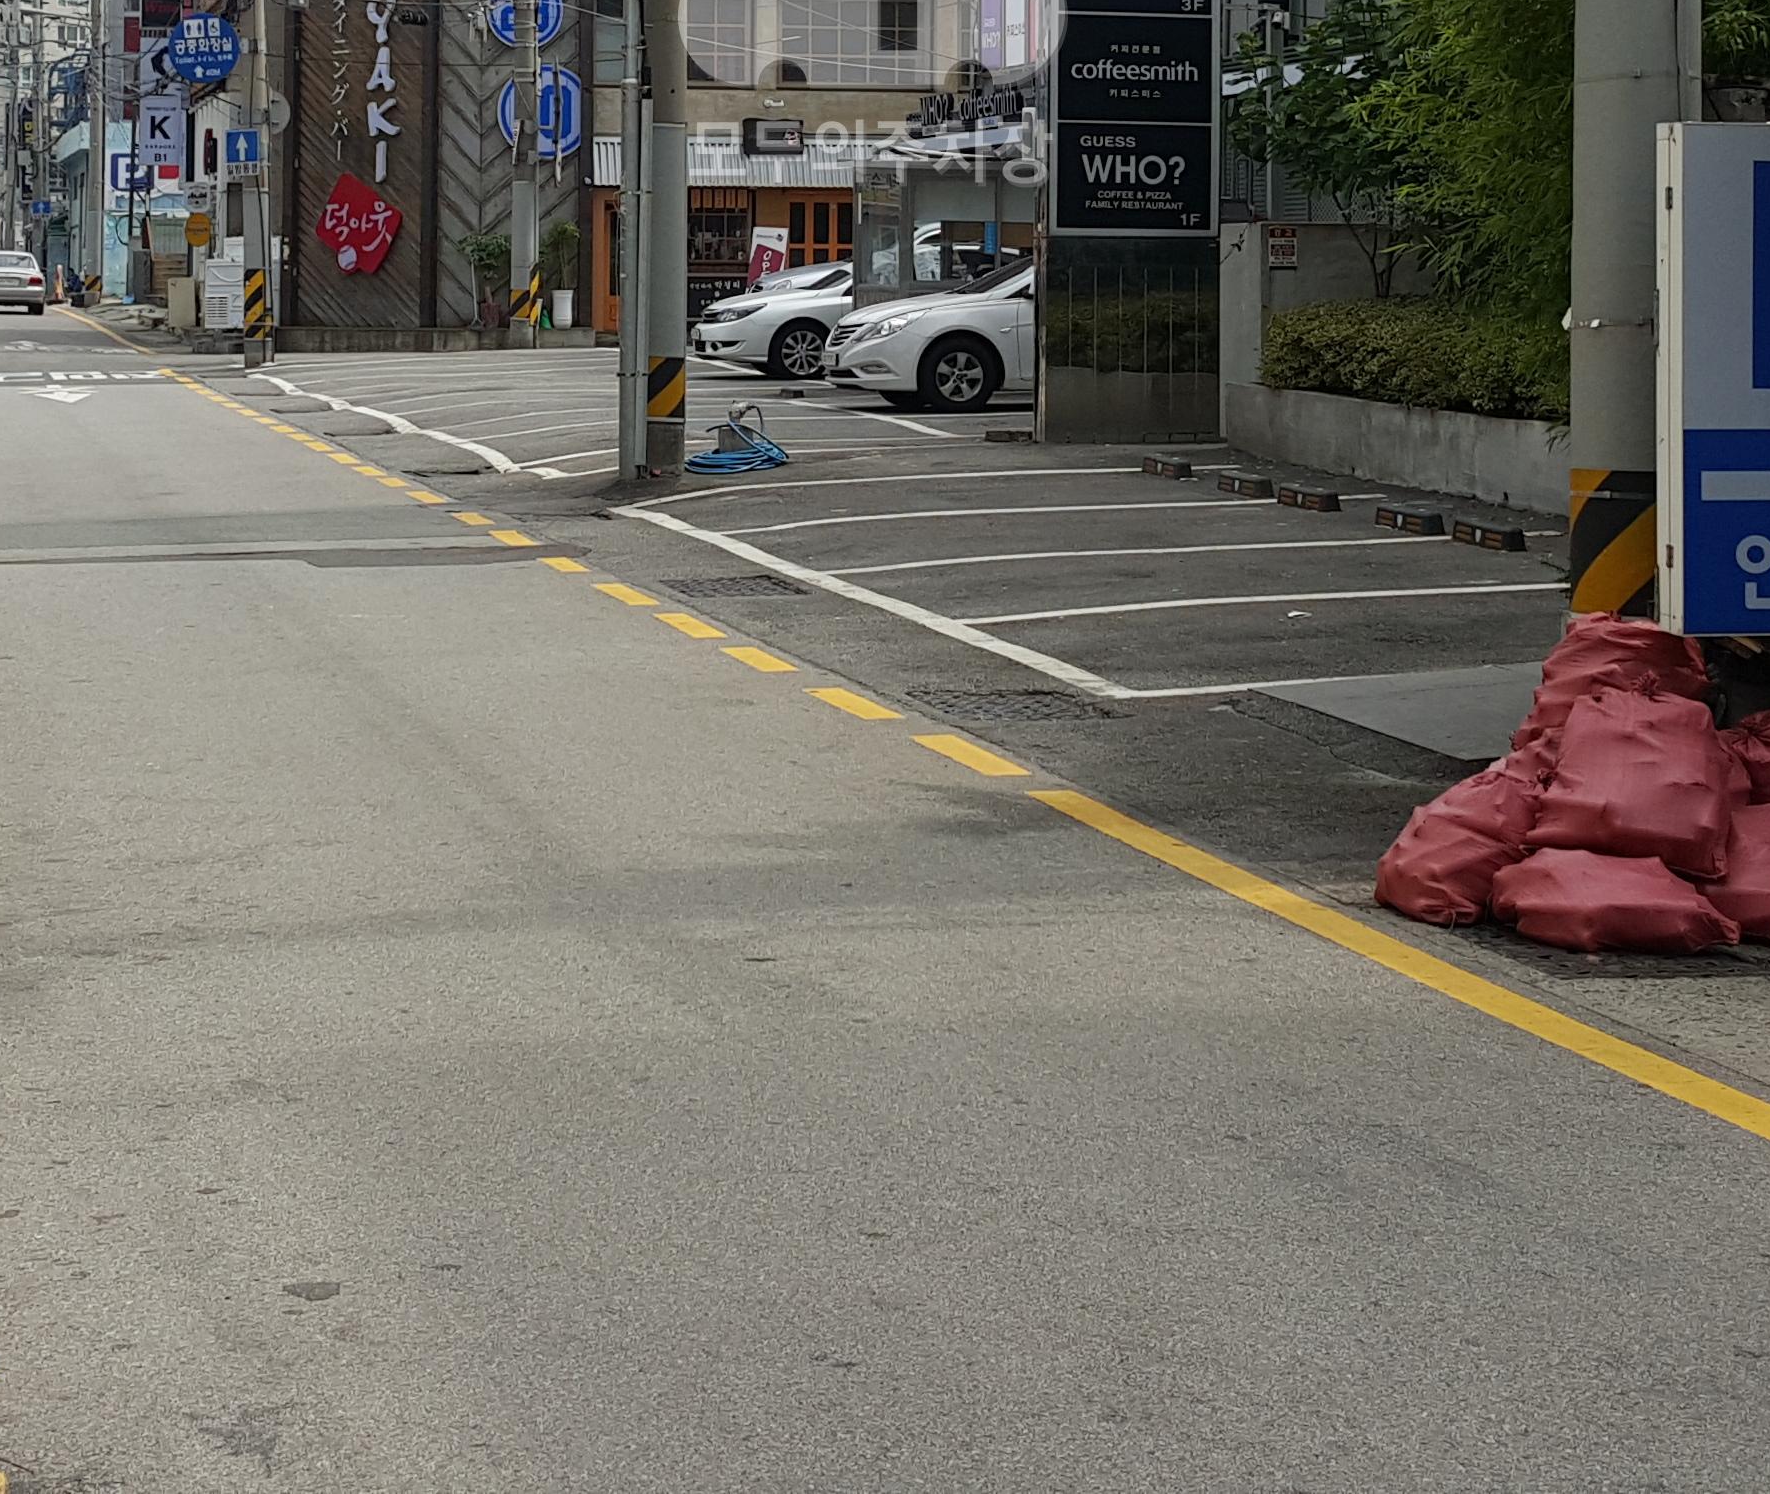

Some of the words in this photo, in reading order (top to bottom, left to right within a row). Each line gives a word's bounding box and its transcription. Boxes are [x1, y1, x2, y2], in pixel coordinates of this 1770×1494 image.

[174, 37, 233, 55] 공중화장실
[1070, 59, 1199, 82] coffeesmith
[1108, 87, 1161, 98] 커피스미스
[958, 85, 1018, 121] coffeesmith
[150, 116, 171, 140] K
[1079, 134, 1136, 148] GUESS
[1081, 153, 1186, 185] WHO?
[1097, 190, 1134, 200] COFFEE
[1136, 191, 1144, 200] &
[1145, 191, 1172, 200] PIZZA
[1085, 199, 1119, 210] FAMILY
[1121, 200, 1184, 210] RESTAURANT
[324, 201, 394, 252] 덕아웃
[1179, 213, 1201, 226] 1F
